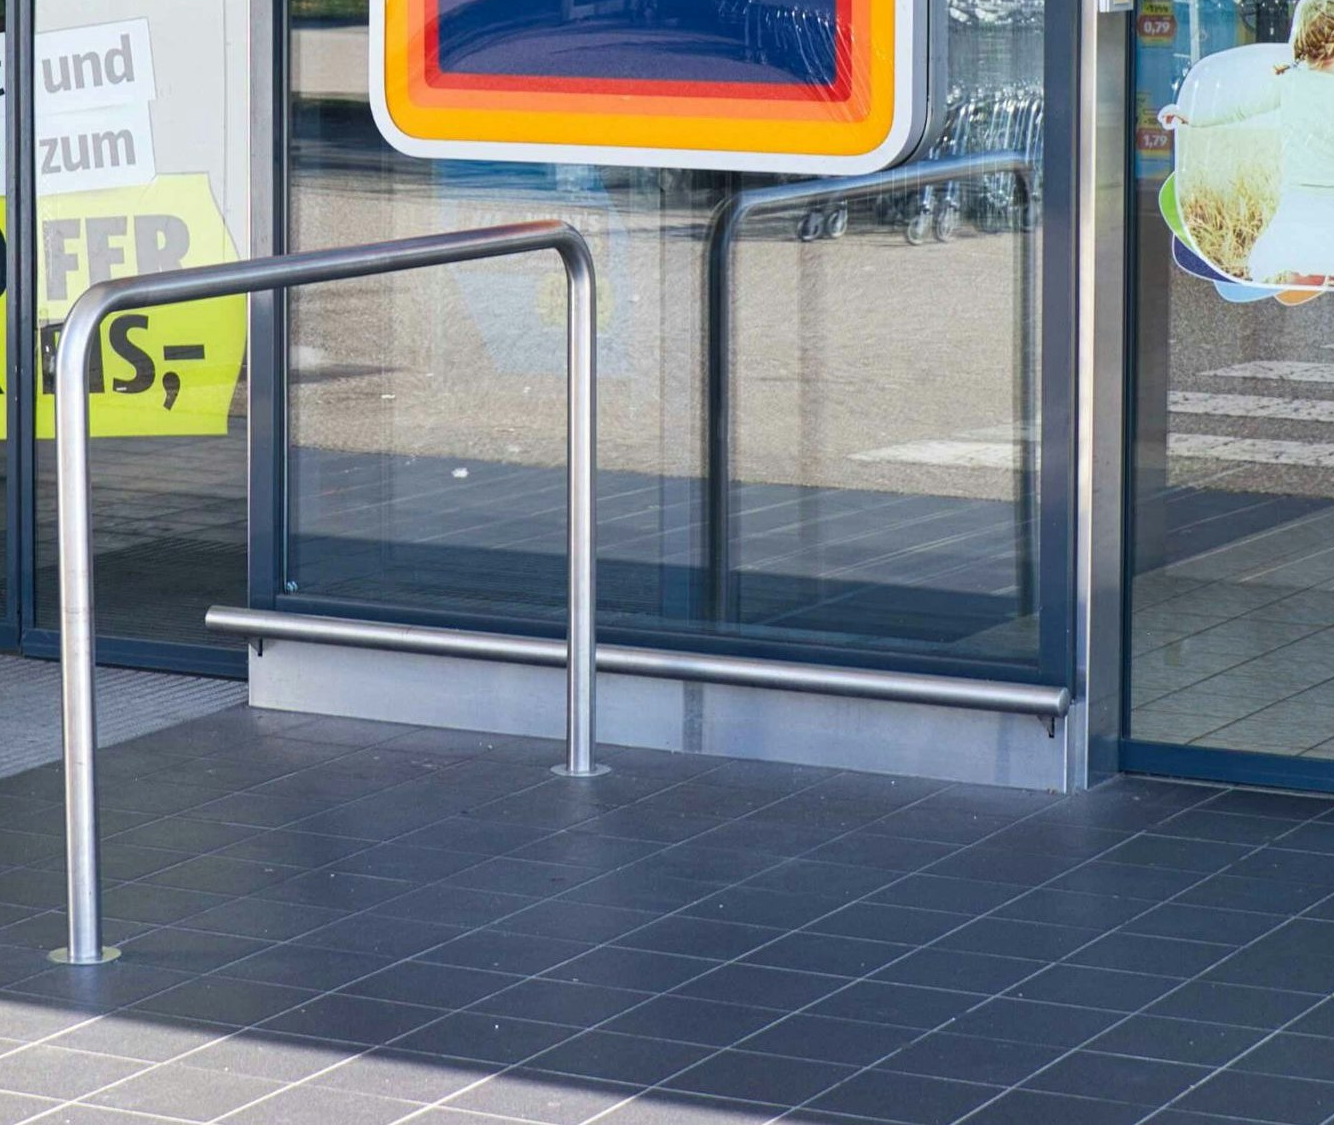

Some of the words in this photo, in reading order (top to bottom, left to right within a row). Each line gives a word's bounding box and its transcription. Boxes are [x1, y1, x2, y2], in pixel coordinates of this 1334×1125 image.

[1143, 22, 1170, 34] 0,79
[42, 34, 134, 93] und
[40, 127, 136, 175] zum
